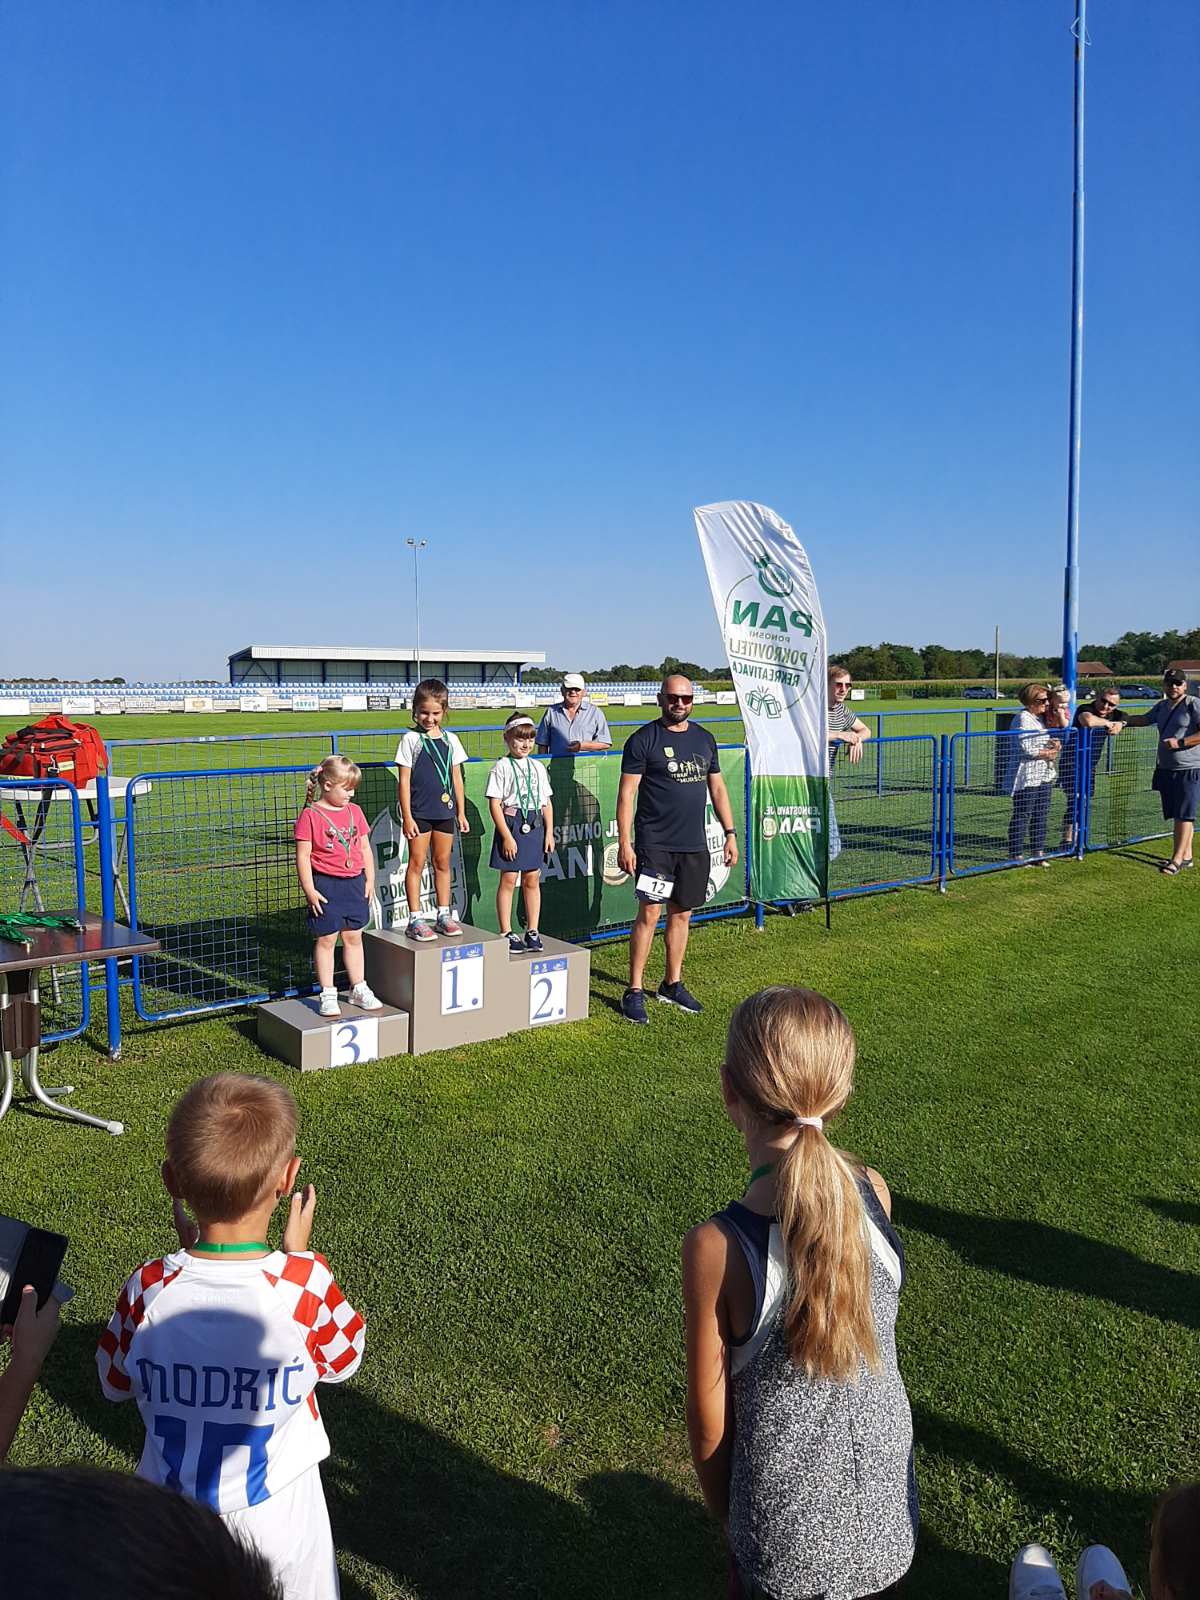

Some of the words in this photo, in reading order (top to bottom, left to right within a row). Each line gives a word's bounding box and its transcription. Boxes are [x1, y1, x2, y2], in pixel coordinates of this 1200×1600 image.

[516, 846, 593, 887] AN
[652, 881, 666, 894] 12
[445, 965, 479, 1010] 1.
[532, 977, 564, 1020] 2.
[136, 1356, 304, 1412] MODRIĆ
[154, 1415, 275, 1515] 10
